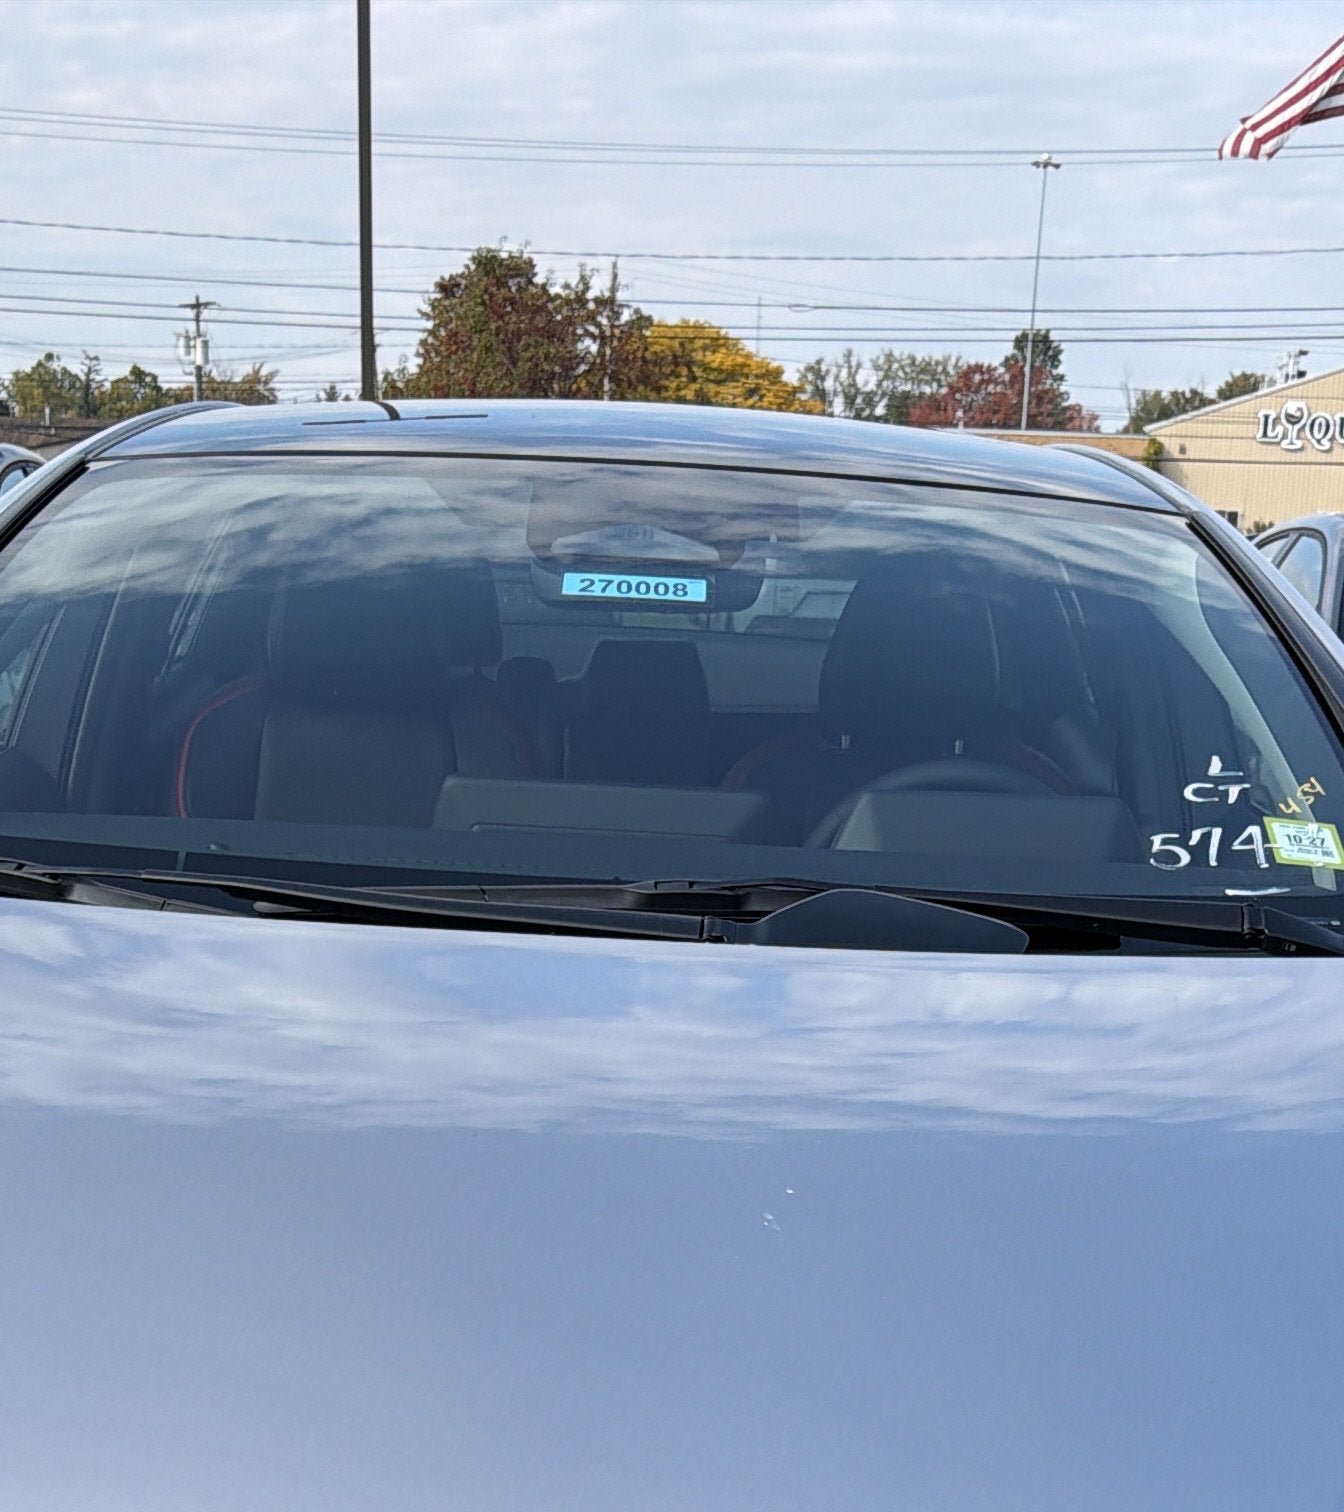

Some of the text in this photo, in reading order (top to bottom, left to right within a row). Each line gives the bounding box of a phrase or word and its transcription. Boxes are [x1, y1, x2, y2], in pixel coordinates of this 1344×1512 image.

[578, 578, 689, 597] 270008
[1207, 755, 1244, 777] L
[1183, 782, 1251, 804] CT
[1149, 825, 1275, 870] 574
